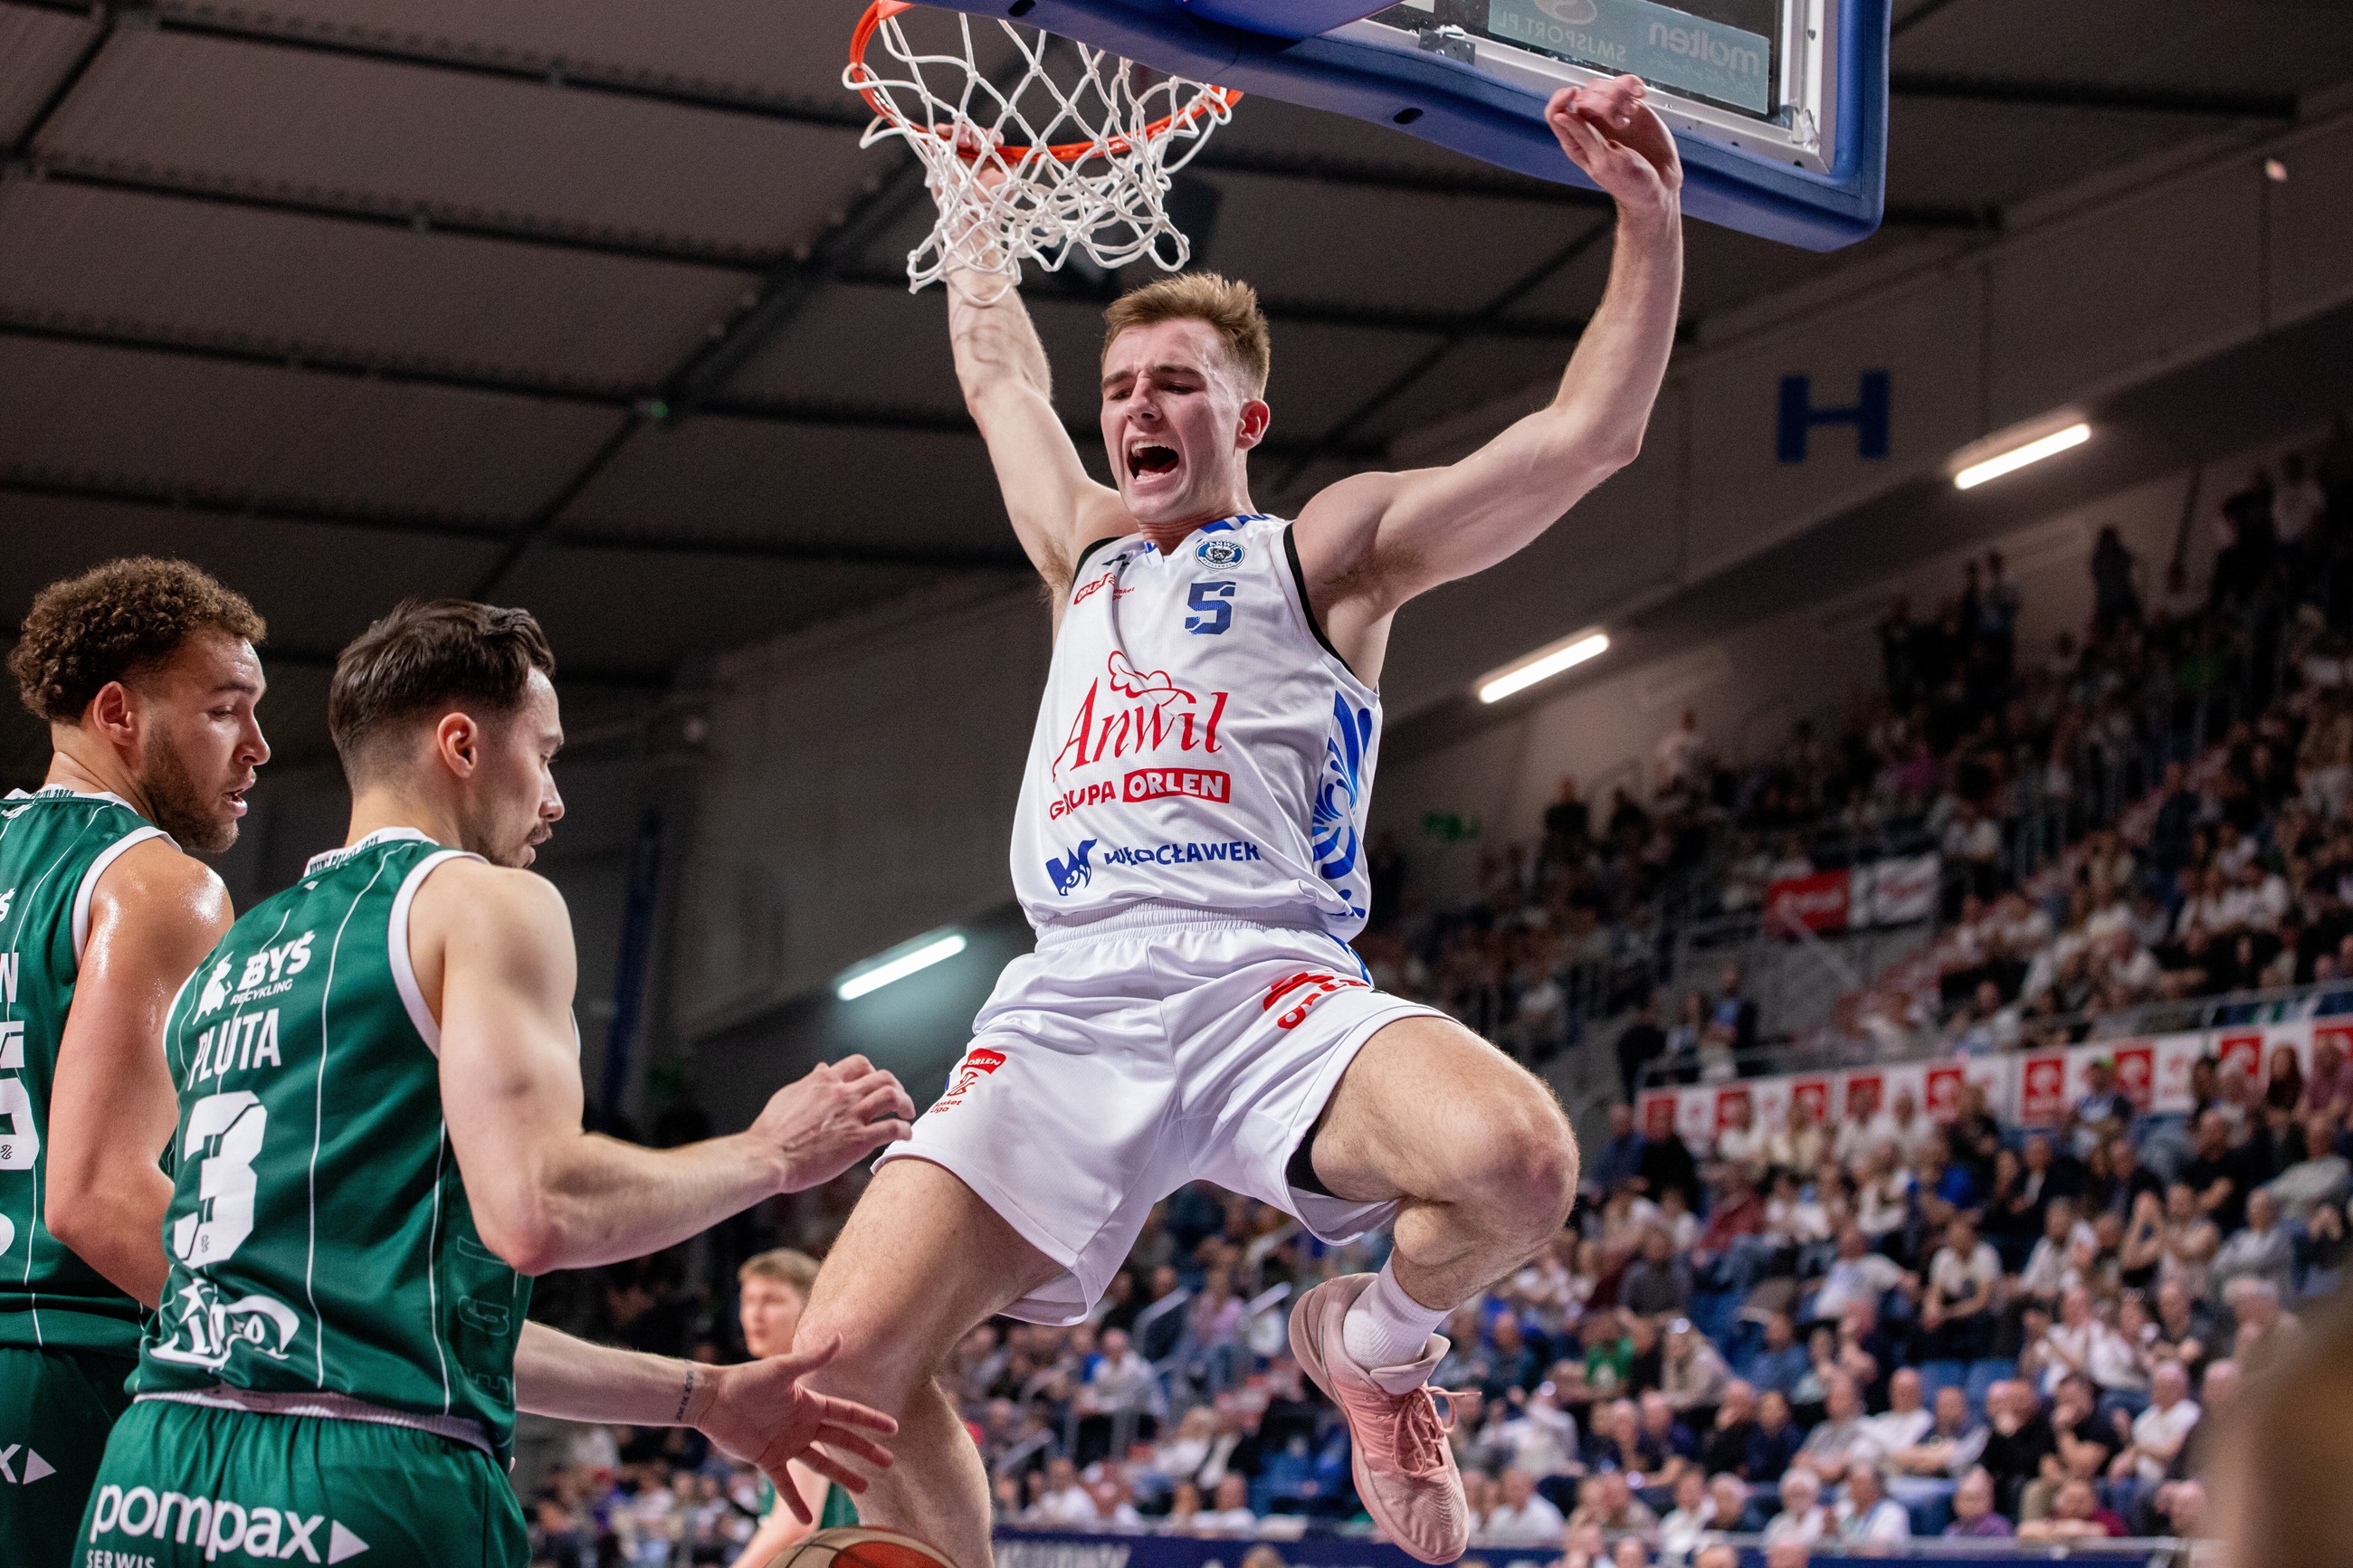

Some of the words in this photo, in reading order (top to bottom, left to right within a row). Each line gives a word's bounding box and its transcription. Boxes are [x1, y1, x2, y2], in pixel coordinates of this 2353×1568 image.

[1777, 369, 1891, 463] H
[1185, 581, 1236, 635] 5
[1053, 677, 1229, 783] Anwil
[1050, 781, 1117, 820] GRUPA
[1129, 772, 1224, 799] ORLEN
[1103, 841, 1262, 866] WŁOCŁAWEK
[230, 978, 293, 1005] RECYKLING
[187, 1008, 281, 1091] PLUTA
[967, 1058, 1002, 1067] ORLEN
[173, 1090, 268, 1270] 3
[89, 1484, 325, 1563] pompax
[86, 1549, 156, 1568] SERWIS
